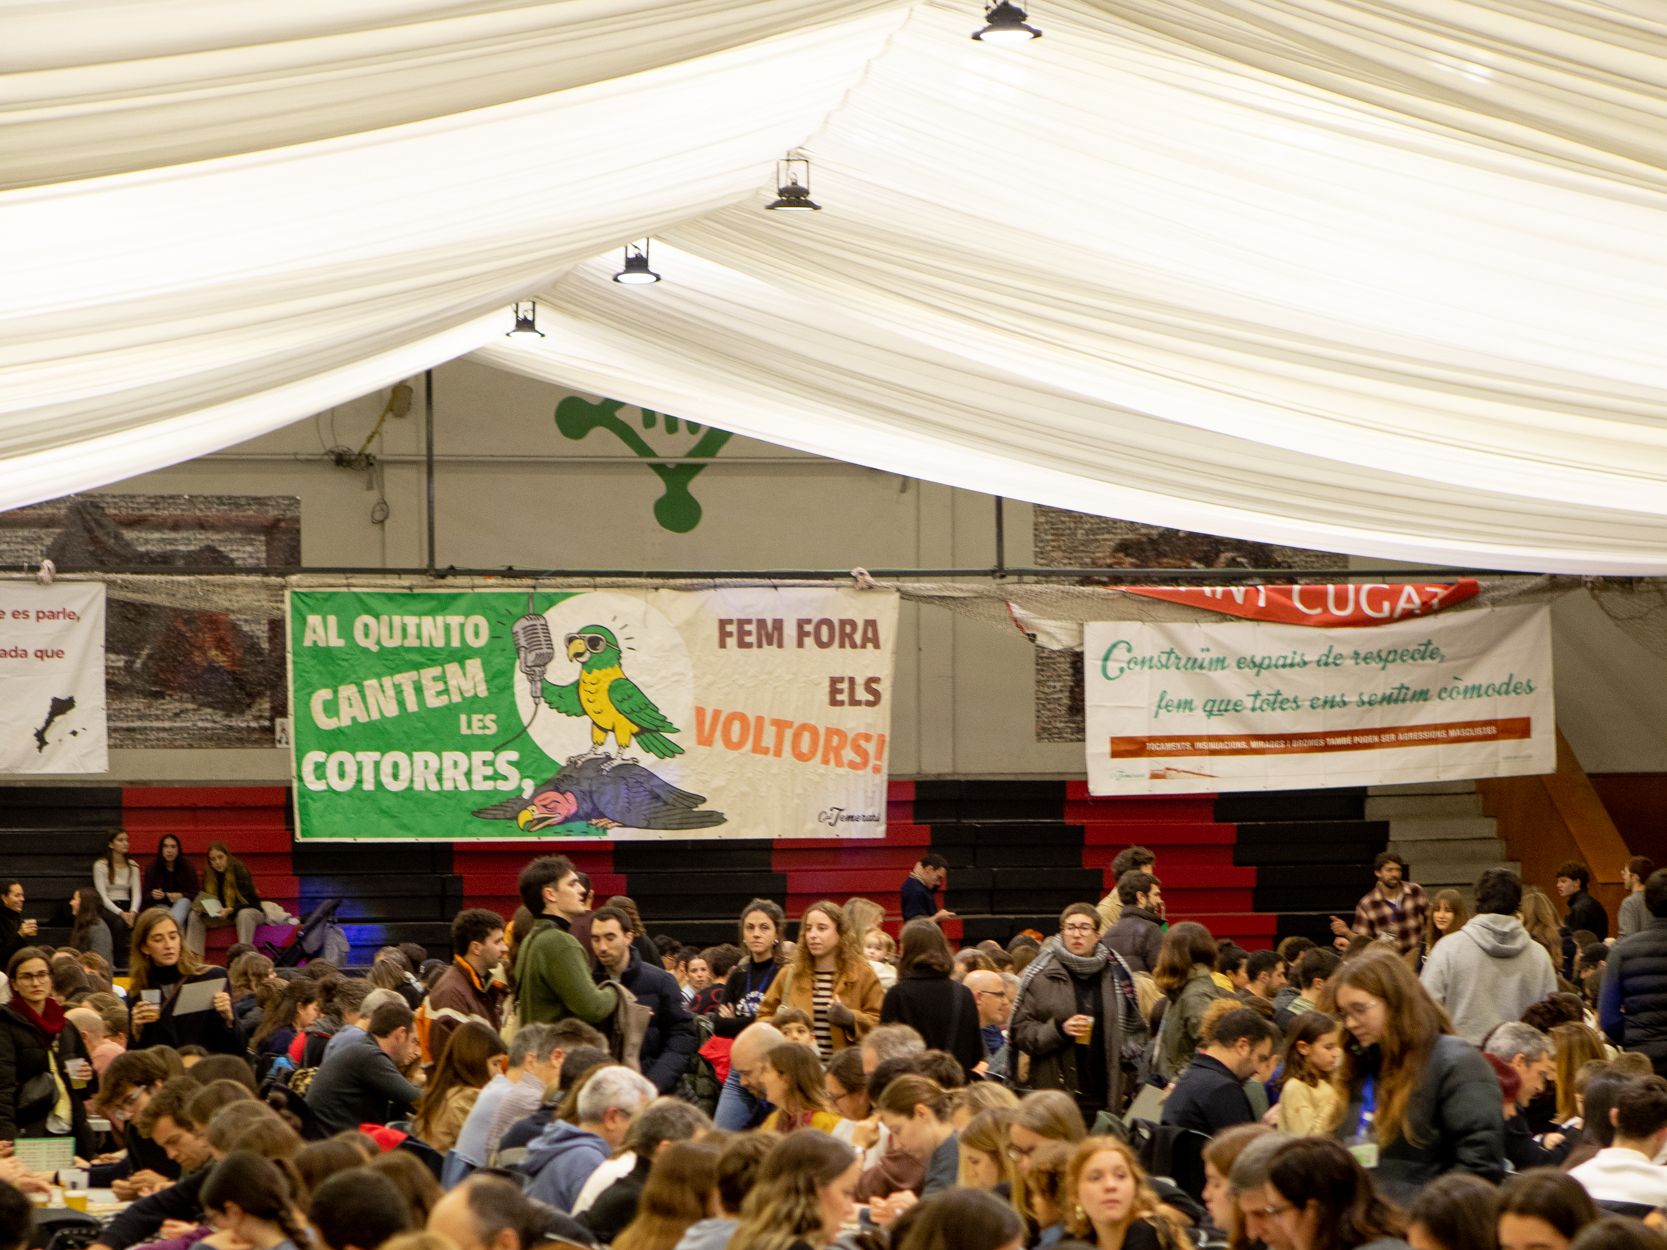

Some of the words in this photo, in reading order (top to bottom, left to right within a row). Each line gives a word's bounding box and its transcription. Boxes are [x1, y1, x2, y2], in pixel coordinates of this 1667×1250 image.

[11, 609, 30, 620] es
[36, 607, 81, 623] parle,
[303, 614, 345, 647] AL
[353, 614, 490, 652] QUINTO
[718, 618, 784, 650] FEM
[796, 618, 881, 650] FORA
[34, 648, 65, 661] que
[1101, 639, 1229, 681] Construïm
[1236, 650, 1309, 677] espais
[1316, 644, 1344, 667] de
[1352, 638, 1446, 671] respecte,
[310, 658, 488, 731] CANTEM
[829, 676, 882, 708] ELS
[1154, 690, 1196, 719] fem
[1202, 698, 1244, 720] que
[1246, 690, 1302, 713] totes
[1309, 693, 1348, 712] ens
[1356, 682, 1431, 708] sentim
[1437, 672, 1537, 701] còmodes
[459, 714, 498, 736] LES
[694, 706, 887, 775] VOLTORS!
[301, 751, 536, 800] COTORRES,
